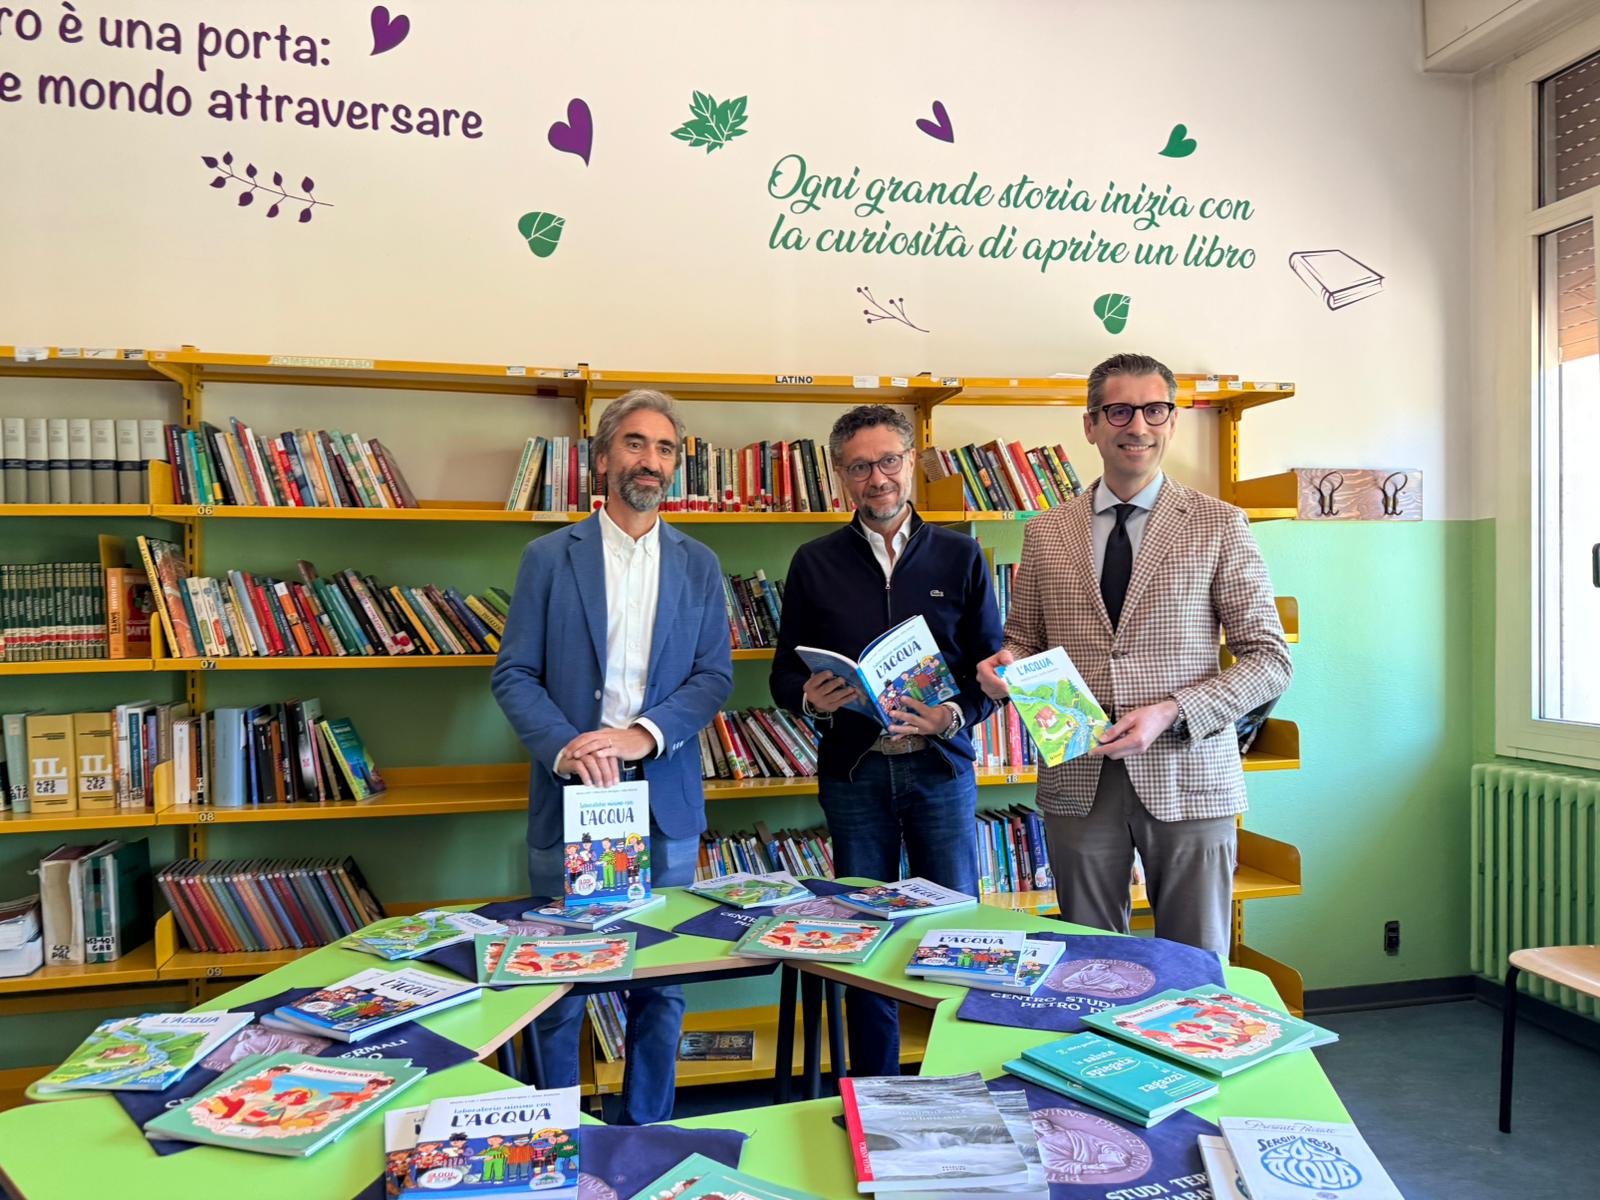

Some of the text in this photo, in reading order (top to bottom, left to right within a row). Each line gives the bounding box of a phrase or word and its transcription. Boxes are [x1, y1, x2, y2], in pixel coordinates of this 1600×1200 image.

[58, 1, 84, 43] è
[99, 15, 182, 54] una
[198, 22, 332, 72] porta:
[38, 69, 193, 117] mondo
[207, 82, 484, 139] attraversare
[768, 154, 1255, 231] Ogni grande storia inizia con
[768, 213, 1257, 273] la curiosità di aprire un libro
[775, 375, 813, 384] LATINO
[198, 506, 214, 515] 06
[200, 660, 216, 669] 07
[876, 641, 922, 679] L'ACQUA
[1016, 657, 1053, 676] L'ACQUA
[32, 758, 68, 778] IL
[80, 755, 113, 775] IL
[199, 812, 215, 822] 08
[580, 807, 635, 826] L'ACQUA
[939, 935, 1004, 945] L'ACQUA
[206, 967, 223, 977] 09
[380, 979, 439, 998] L'ACQUA
[990, 992, 1057, 1003] CENTRO
[1020, 1001, 1081, 1011] PIETRO
[161, 1016, 220, 1024] L'ACQUA
[336, 1039, 408, 1061] ERMALI
[1138, 1071, 1187, 1092] ragazzi
[451, 1108, 551, 1127] L'ACQUA
[454, 1106, 501, 1114] Laboratorio
[1257, 1135, 1296, 1152] SERGIO
[1266, 1140, 1338, 1160] SOS
[1263, 1159, 1359, 1189] ACQUA
[1105, 1183, 1170, 1200] STUDI
